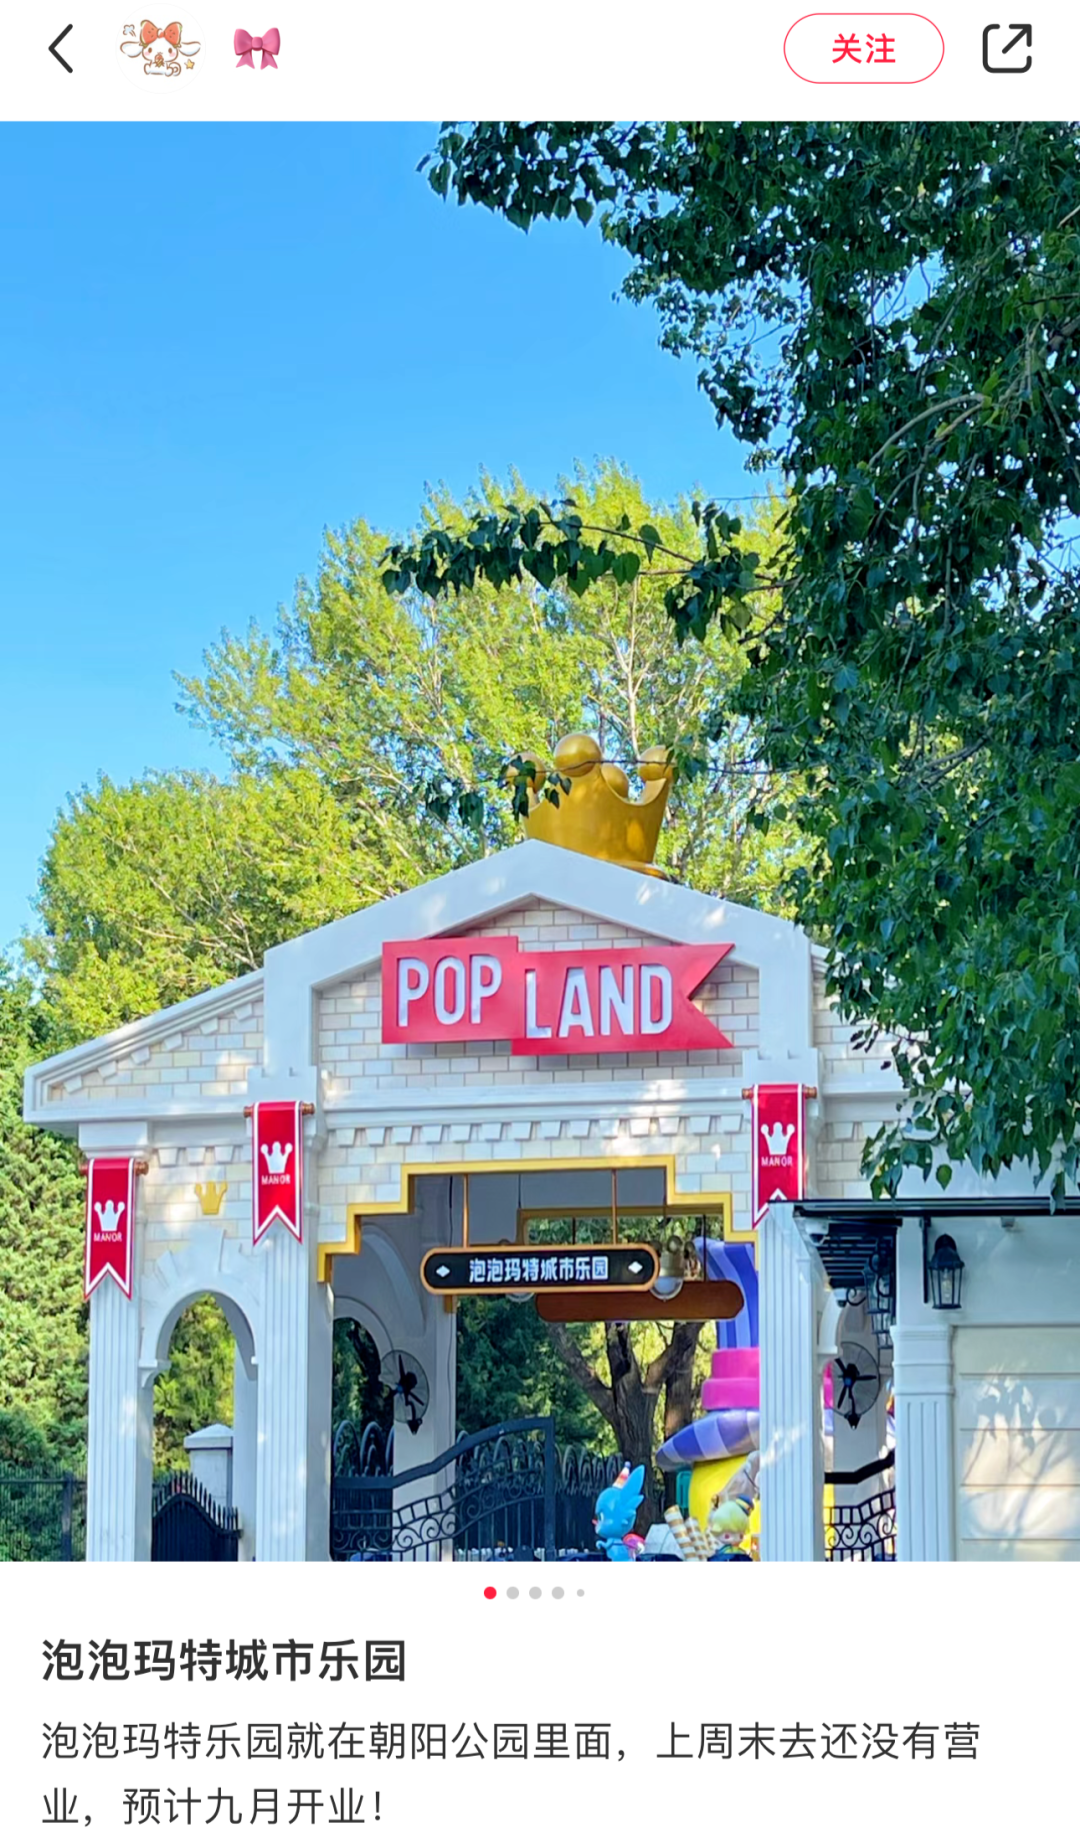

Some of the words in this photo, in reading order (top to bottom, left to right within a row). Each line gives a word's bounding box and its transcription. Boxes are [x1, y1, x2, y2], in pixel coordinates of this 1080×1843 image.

[397, 953, 502, 1028] POP
[525, 963, 673, 1039] LAND
[760, 1156, 793, 1167] MANOR
[261, 1174, 291, 1186] MANOR
[93, 1232, 123, 1243] MANOR
[468, 1256, 610, 1283] 泡泡玛特城市乐园
